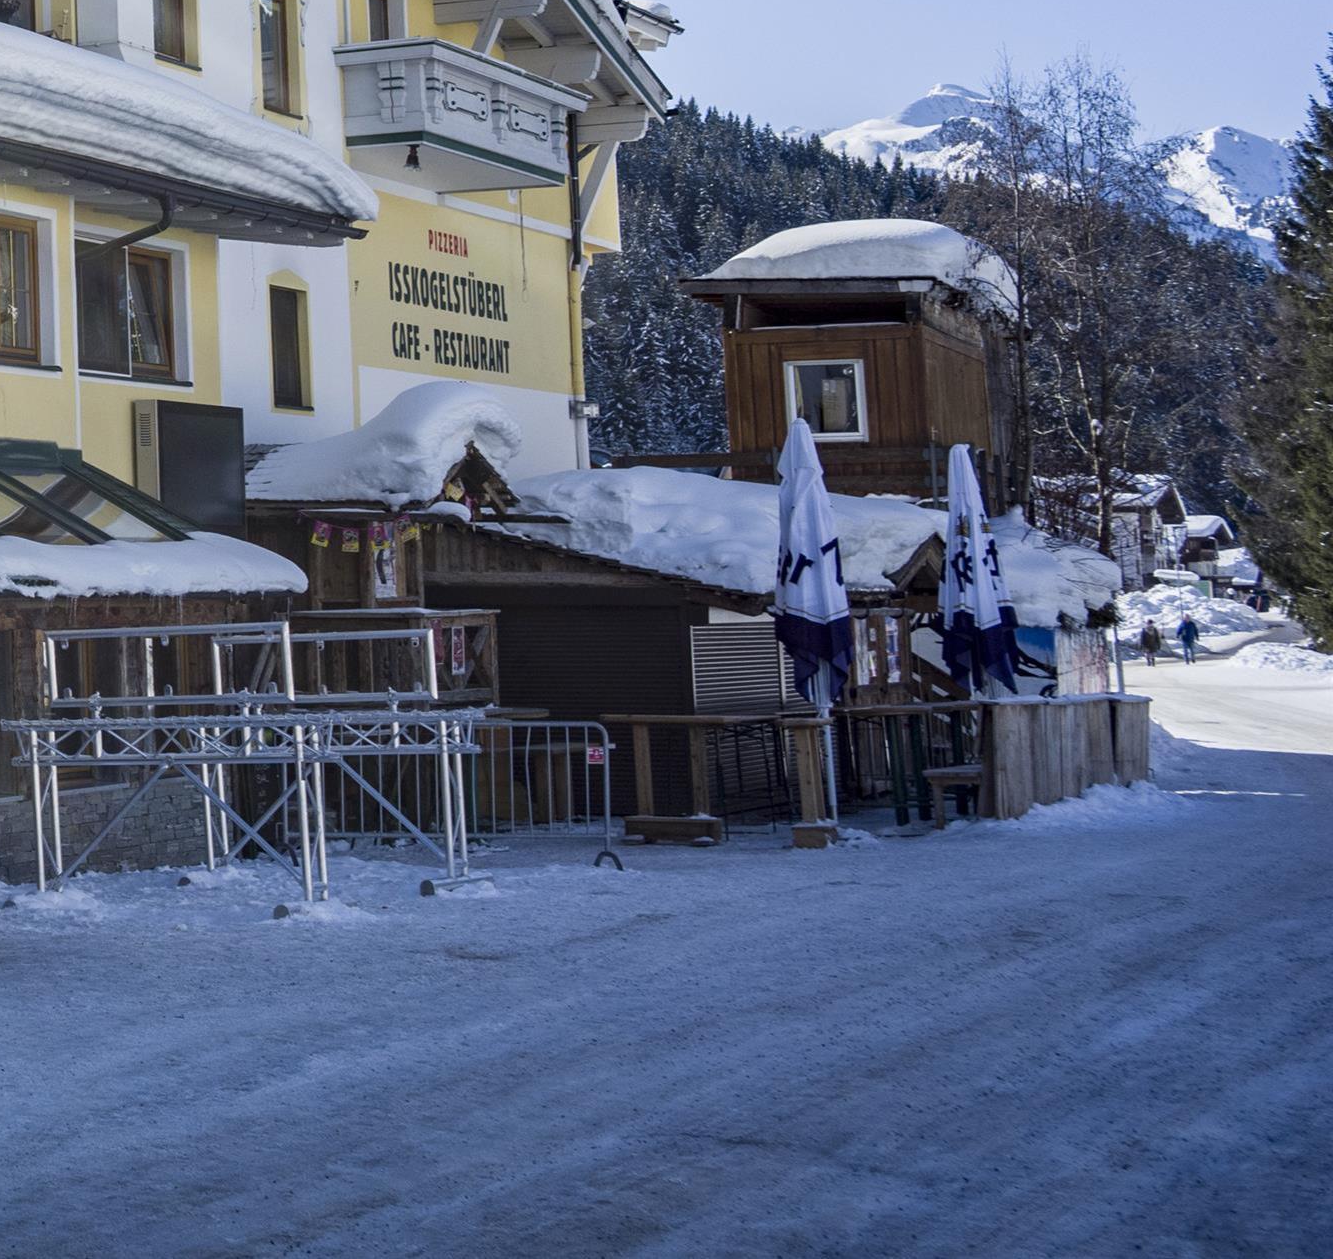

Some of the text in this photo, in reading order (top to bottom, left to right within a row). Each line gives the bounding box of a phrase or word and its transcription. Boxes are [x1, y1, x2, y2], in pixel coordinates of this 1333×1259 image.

[428, 229, 469, 258] PIZZERIA
[388, 261, 509, 322] ISSKOGELSTÜBERL
[391, 321, 421, 360] CAFE
[433, 328, 510, 374] RESTAURANT
